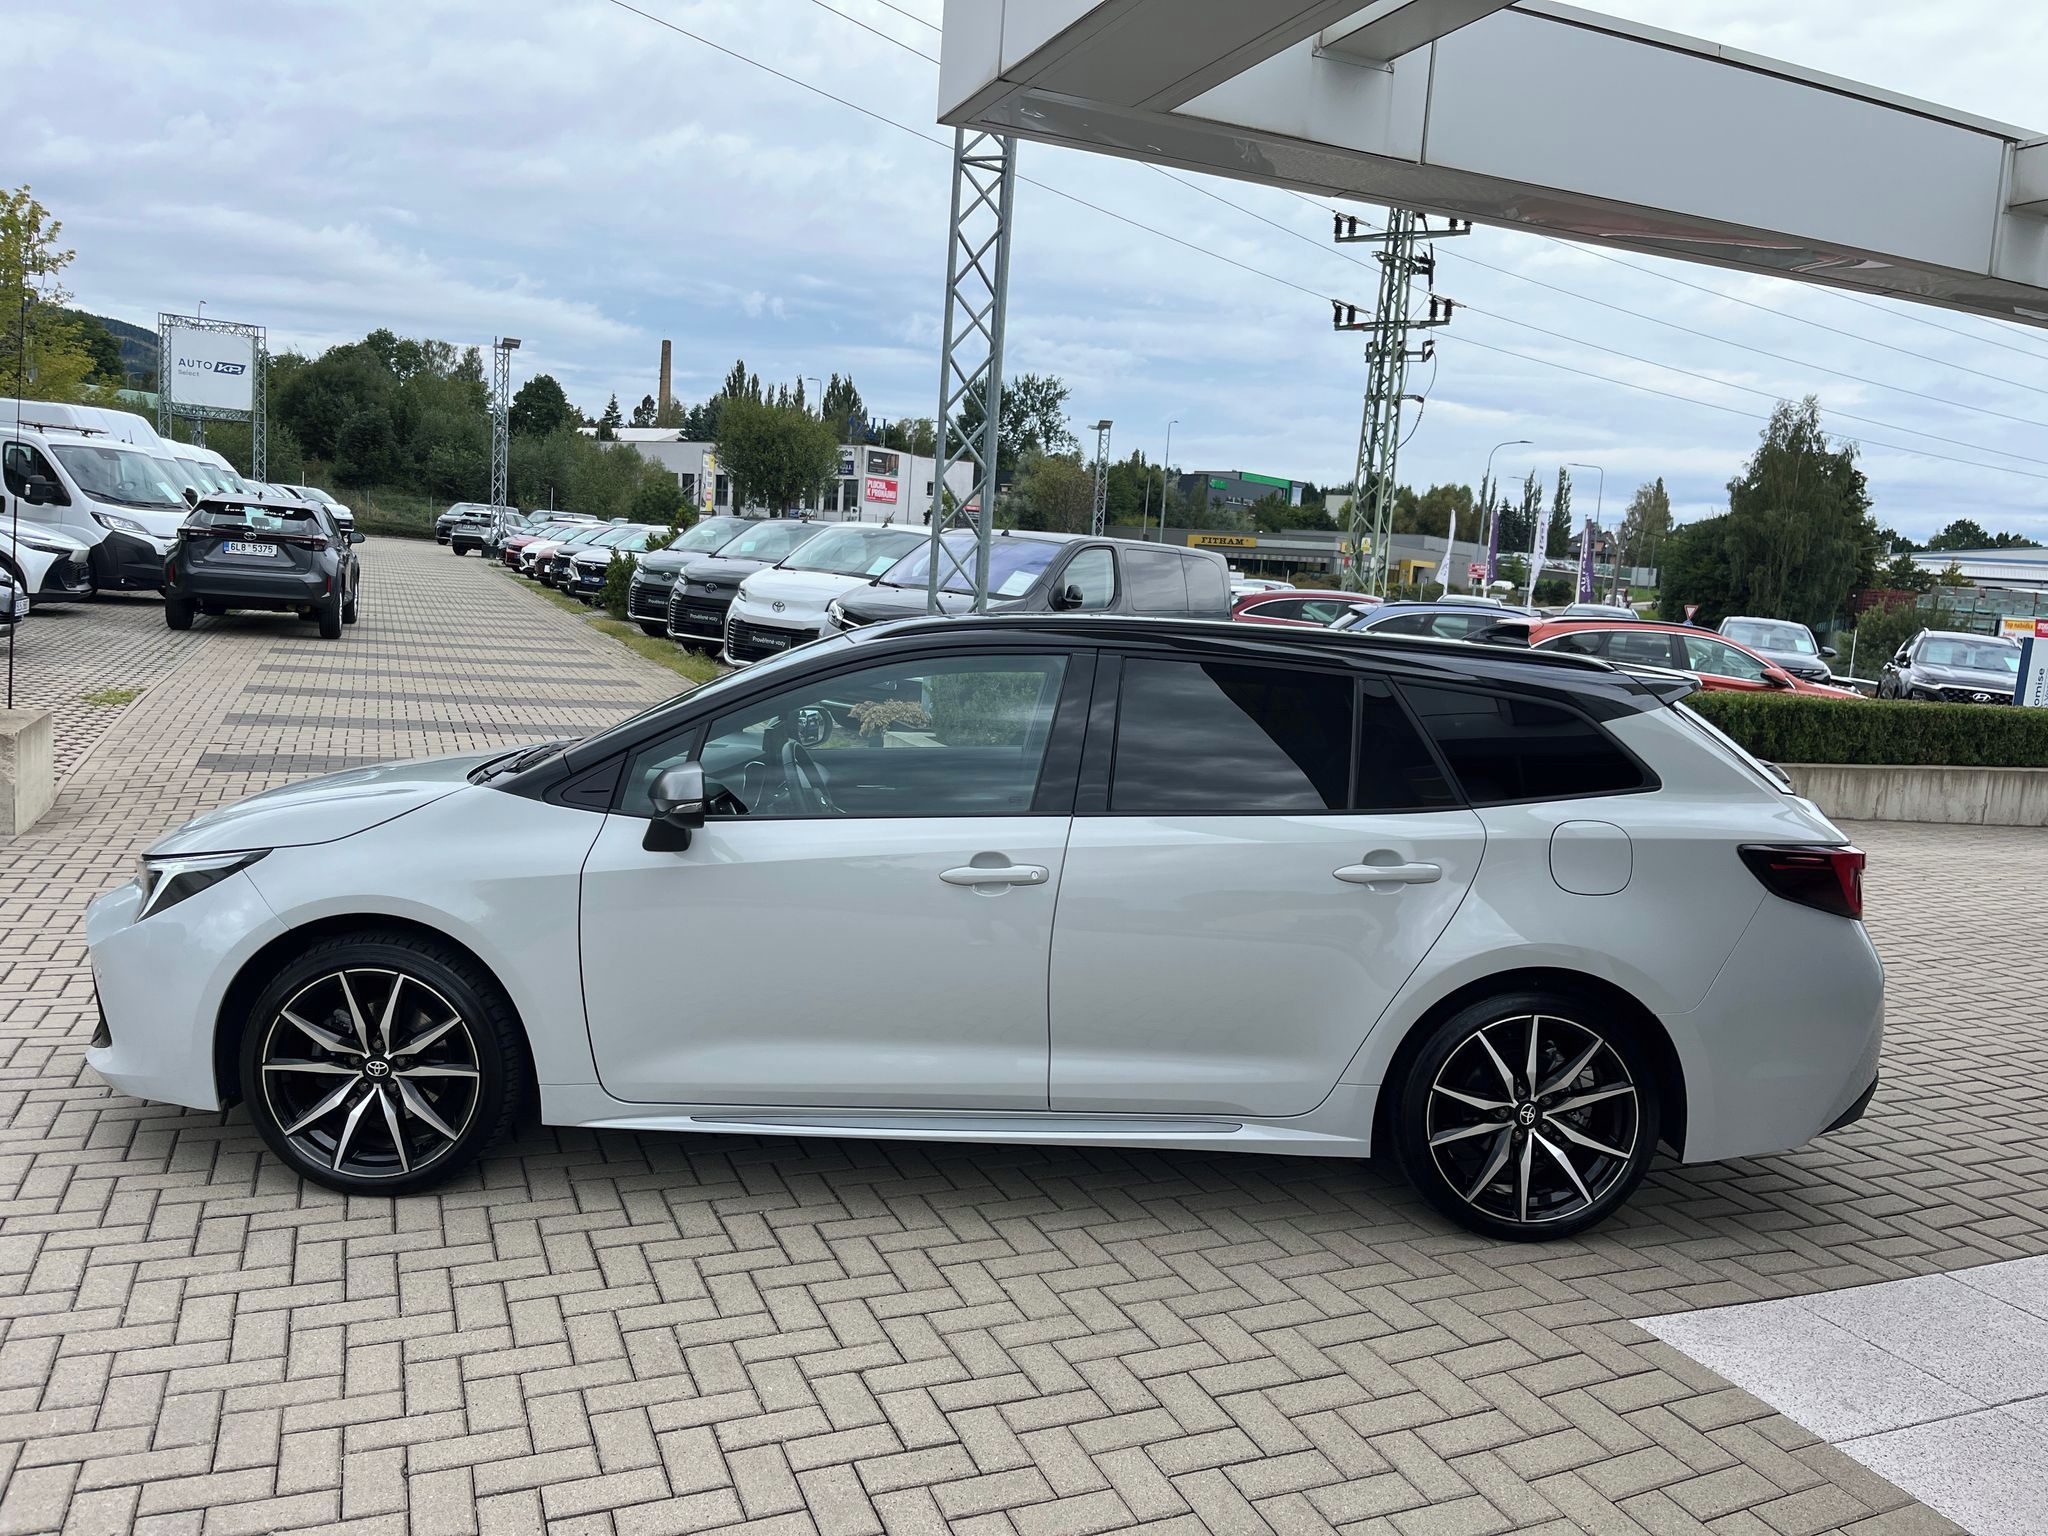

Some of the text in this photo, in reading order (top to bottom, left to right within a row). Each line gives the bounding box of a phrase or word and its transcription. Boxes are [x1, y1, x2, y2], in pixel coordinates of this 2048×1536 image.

[178, 358, 212, 369] AUTO
[230, 543, 273, 553] 6L8 5375
